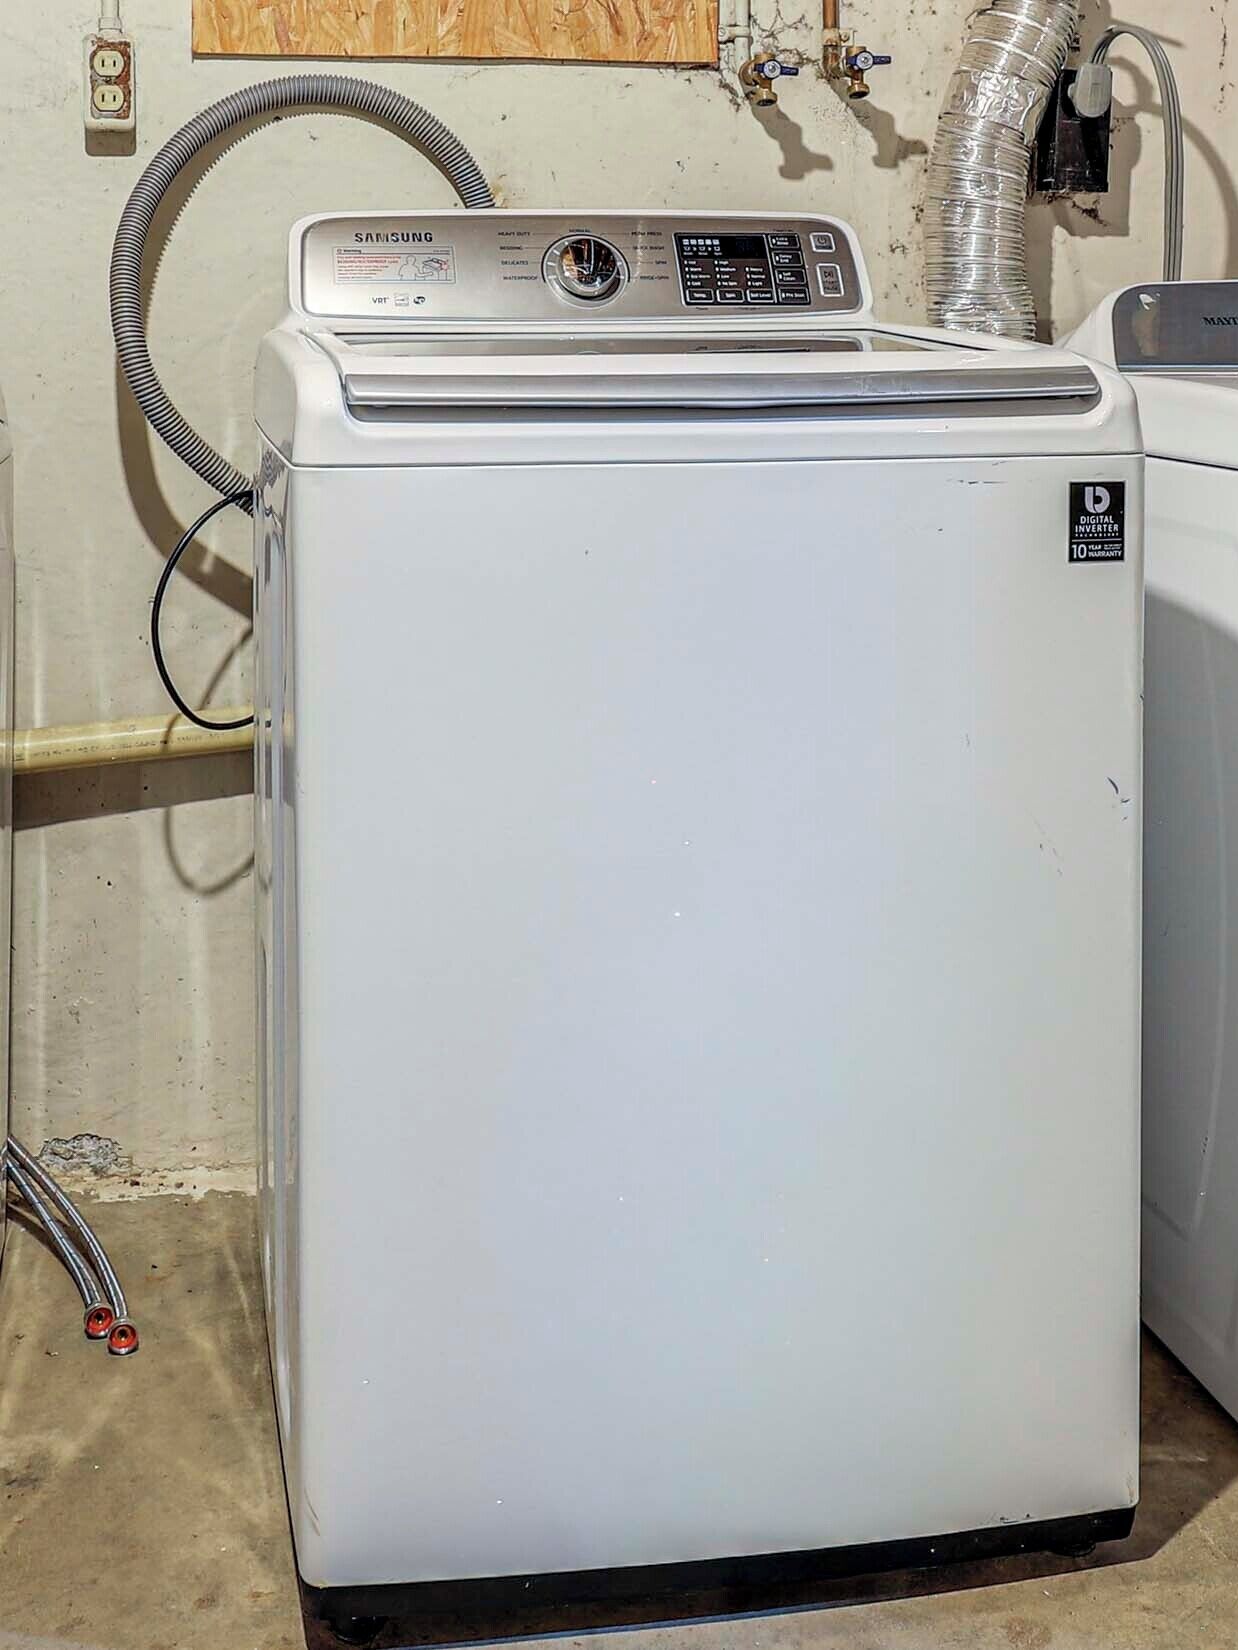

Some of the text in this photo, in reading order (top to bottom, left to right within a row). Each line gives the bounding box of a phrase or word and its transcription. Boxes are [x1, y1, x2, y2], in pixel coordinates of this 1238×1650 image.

[354, 232, 433, 243] SAMSUNG
[1080, 515, 1114, 524] DIGITAL
[1075, 524, 1119, 533] INVERTER
[1071, 543, 1087, 559] 10
[1088, 550, 1122, 558] WARRANTY
